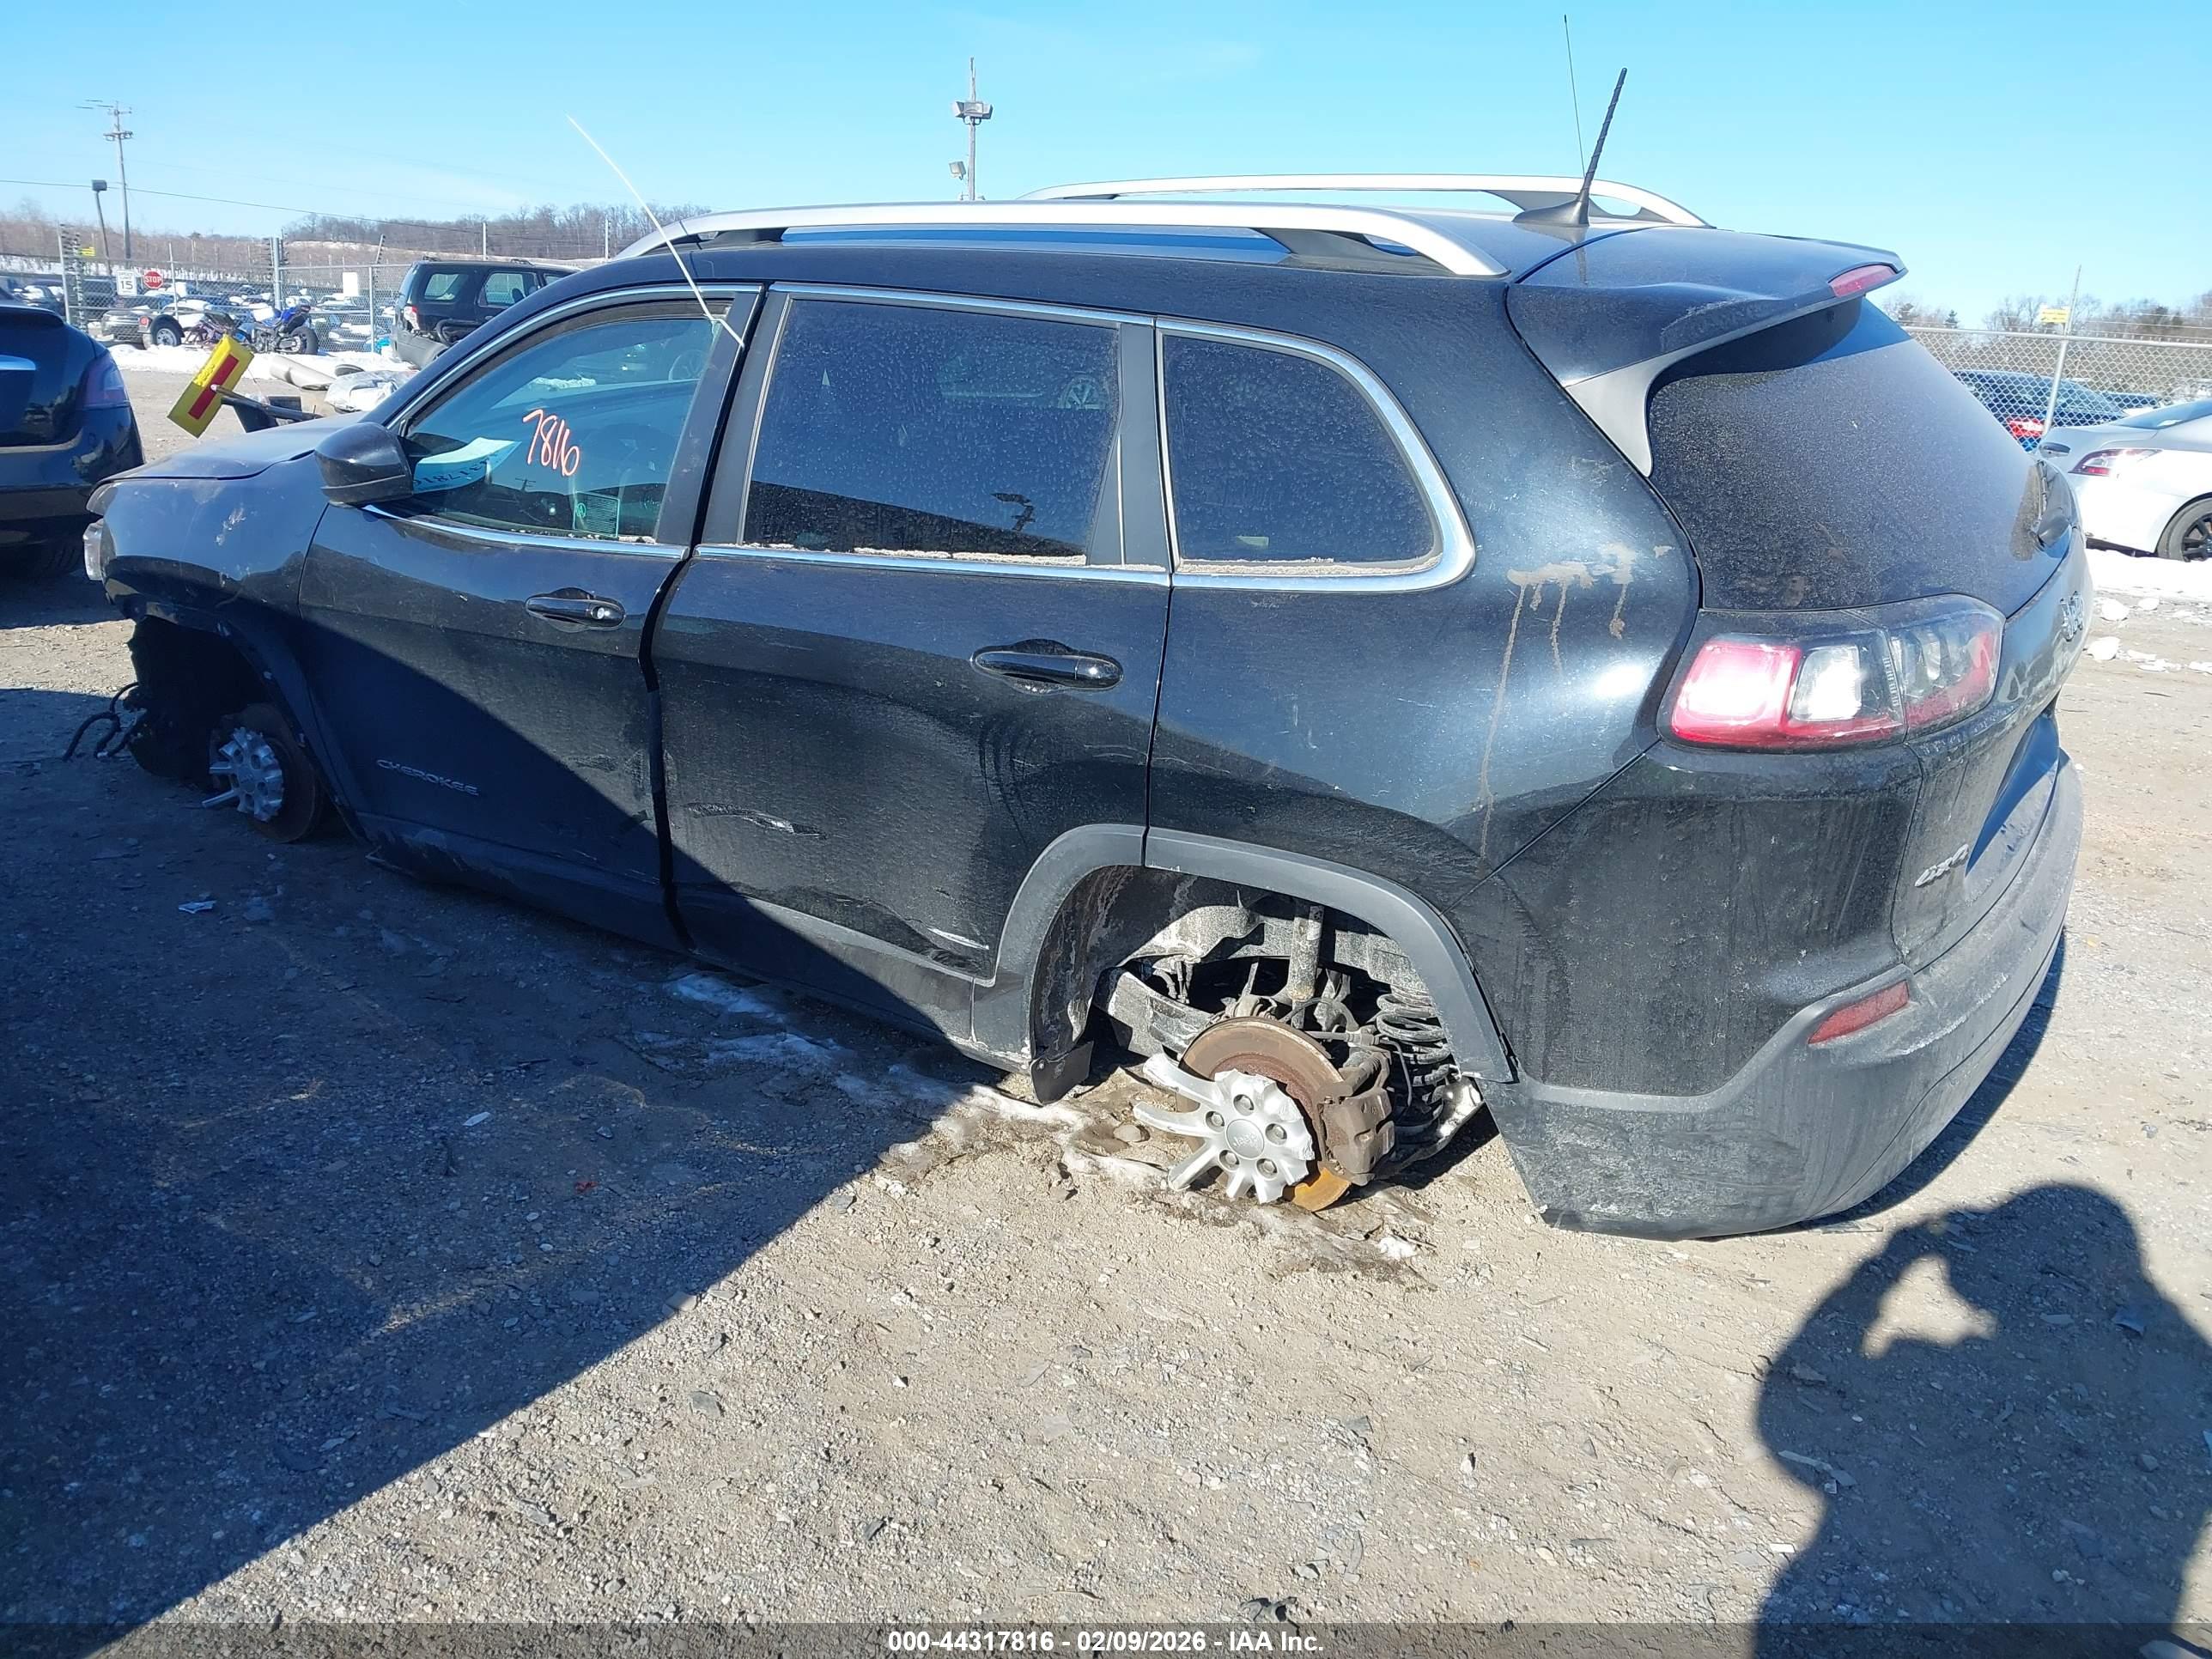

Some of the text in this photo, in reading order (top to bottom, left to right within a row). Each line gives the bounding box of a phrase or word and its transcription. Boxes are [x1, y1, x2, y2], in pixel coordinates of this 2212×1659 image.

[120, 280, 133, 289] 15
[522, 409, 580, 477] 7816
[376, 758, 480, 796] CHEROKEE
[1232, 1133, 1259, 1148] Jeep
